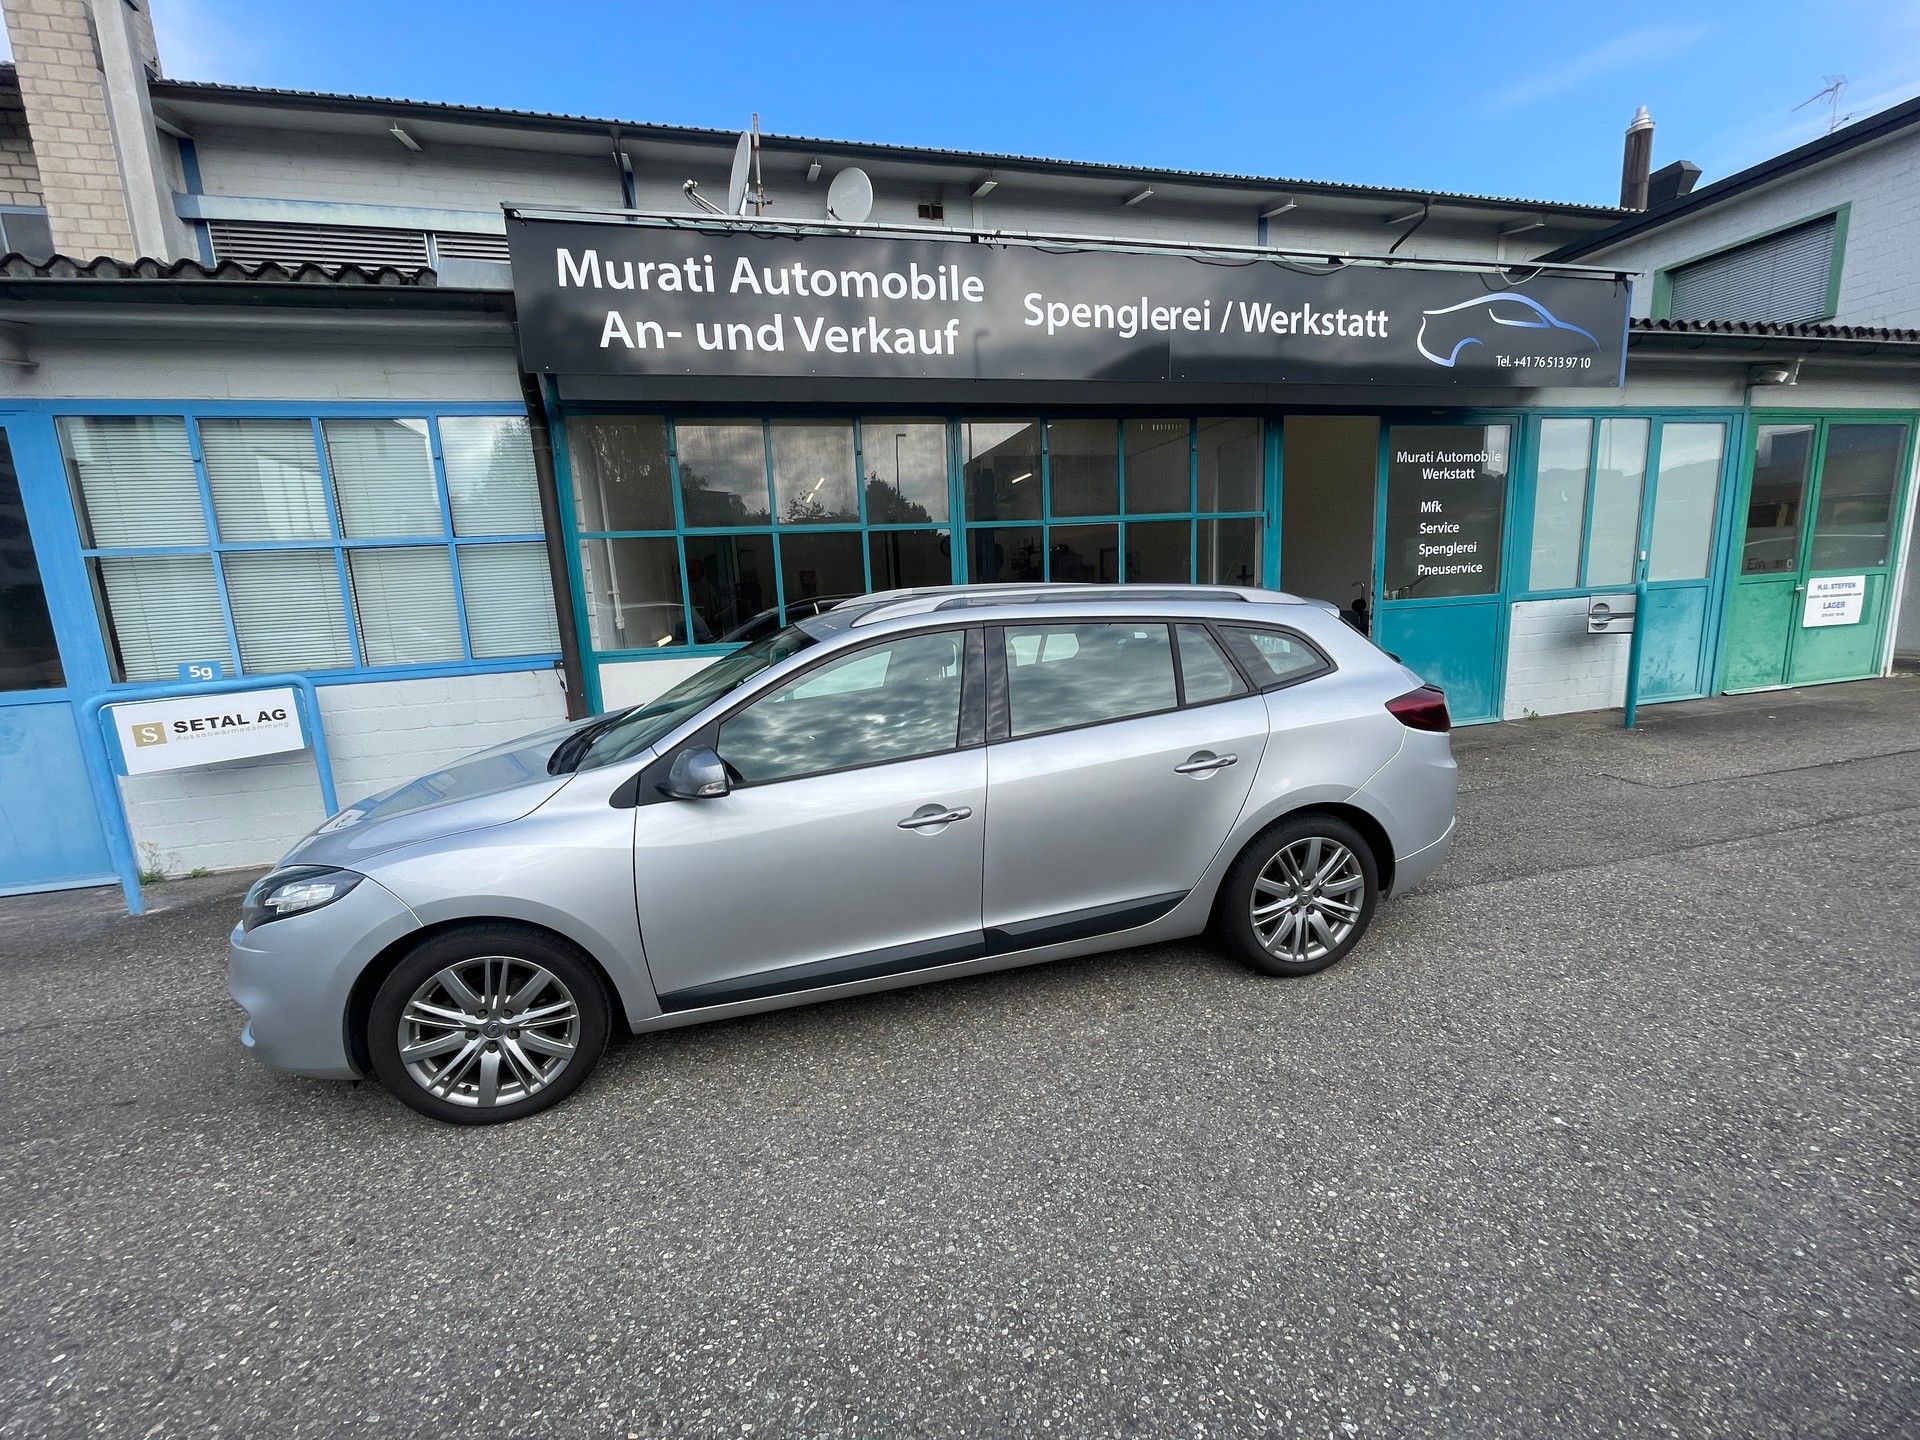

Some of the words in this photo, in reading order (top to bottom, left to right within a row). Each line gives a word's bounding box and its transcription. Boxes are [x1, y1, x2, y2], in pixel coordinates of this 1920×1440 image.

[556, 248, 715, 293] Murati
[729, 256, 985, 303] Automobile
[1023, 292, 1211, 339] Spenglerei
[1220, 301, 1233, 334] /
[1239, 302, 1389, 339] Werkstatt
[600, 310, 683, 349] An-
[695, 314, 784, 352] und
[793, 316, 960, 355] Verkauf
[1496, 355, 1511, 368] Tel.
[1514, 356, 1531, 368] +41
[1534, 356, 1545, 368] 76
[1547, 357, 1564, 368] 513
[1566, 357, 1578, 368] 97
[1580, 357, 1591, 369] 10
[1396, 450, 1434, 463] Murati
[1436, 450, 1502, 463] Automobile
[1422, 467, 1476, 480] Werkstatt
[1420, 500, 1443, 513] Mfk
[1419, 521, 1460, 535] Service
[1418, 541, 1477, 558] Spenglerei
[1417, 562, 1483, 576] Pneuservice
[1822, 601, 1846, 609] LAGER
[188, 665, 213, 680] 5g
[173, 713, 250, 734] SETAL
[257, 708, 287, 723] AG
[141, 727, 159, 743] S
